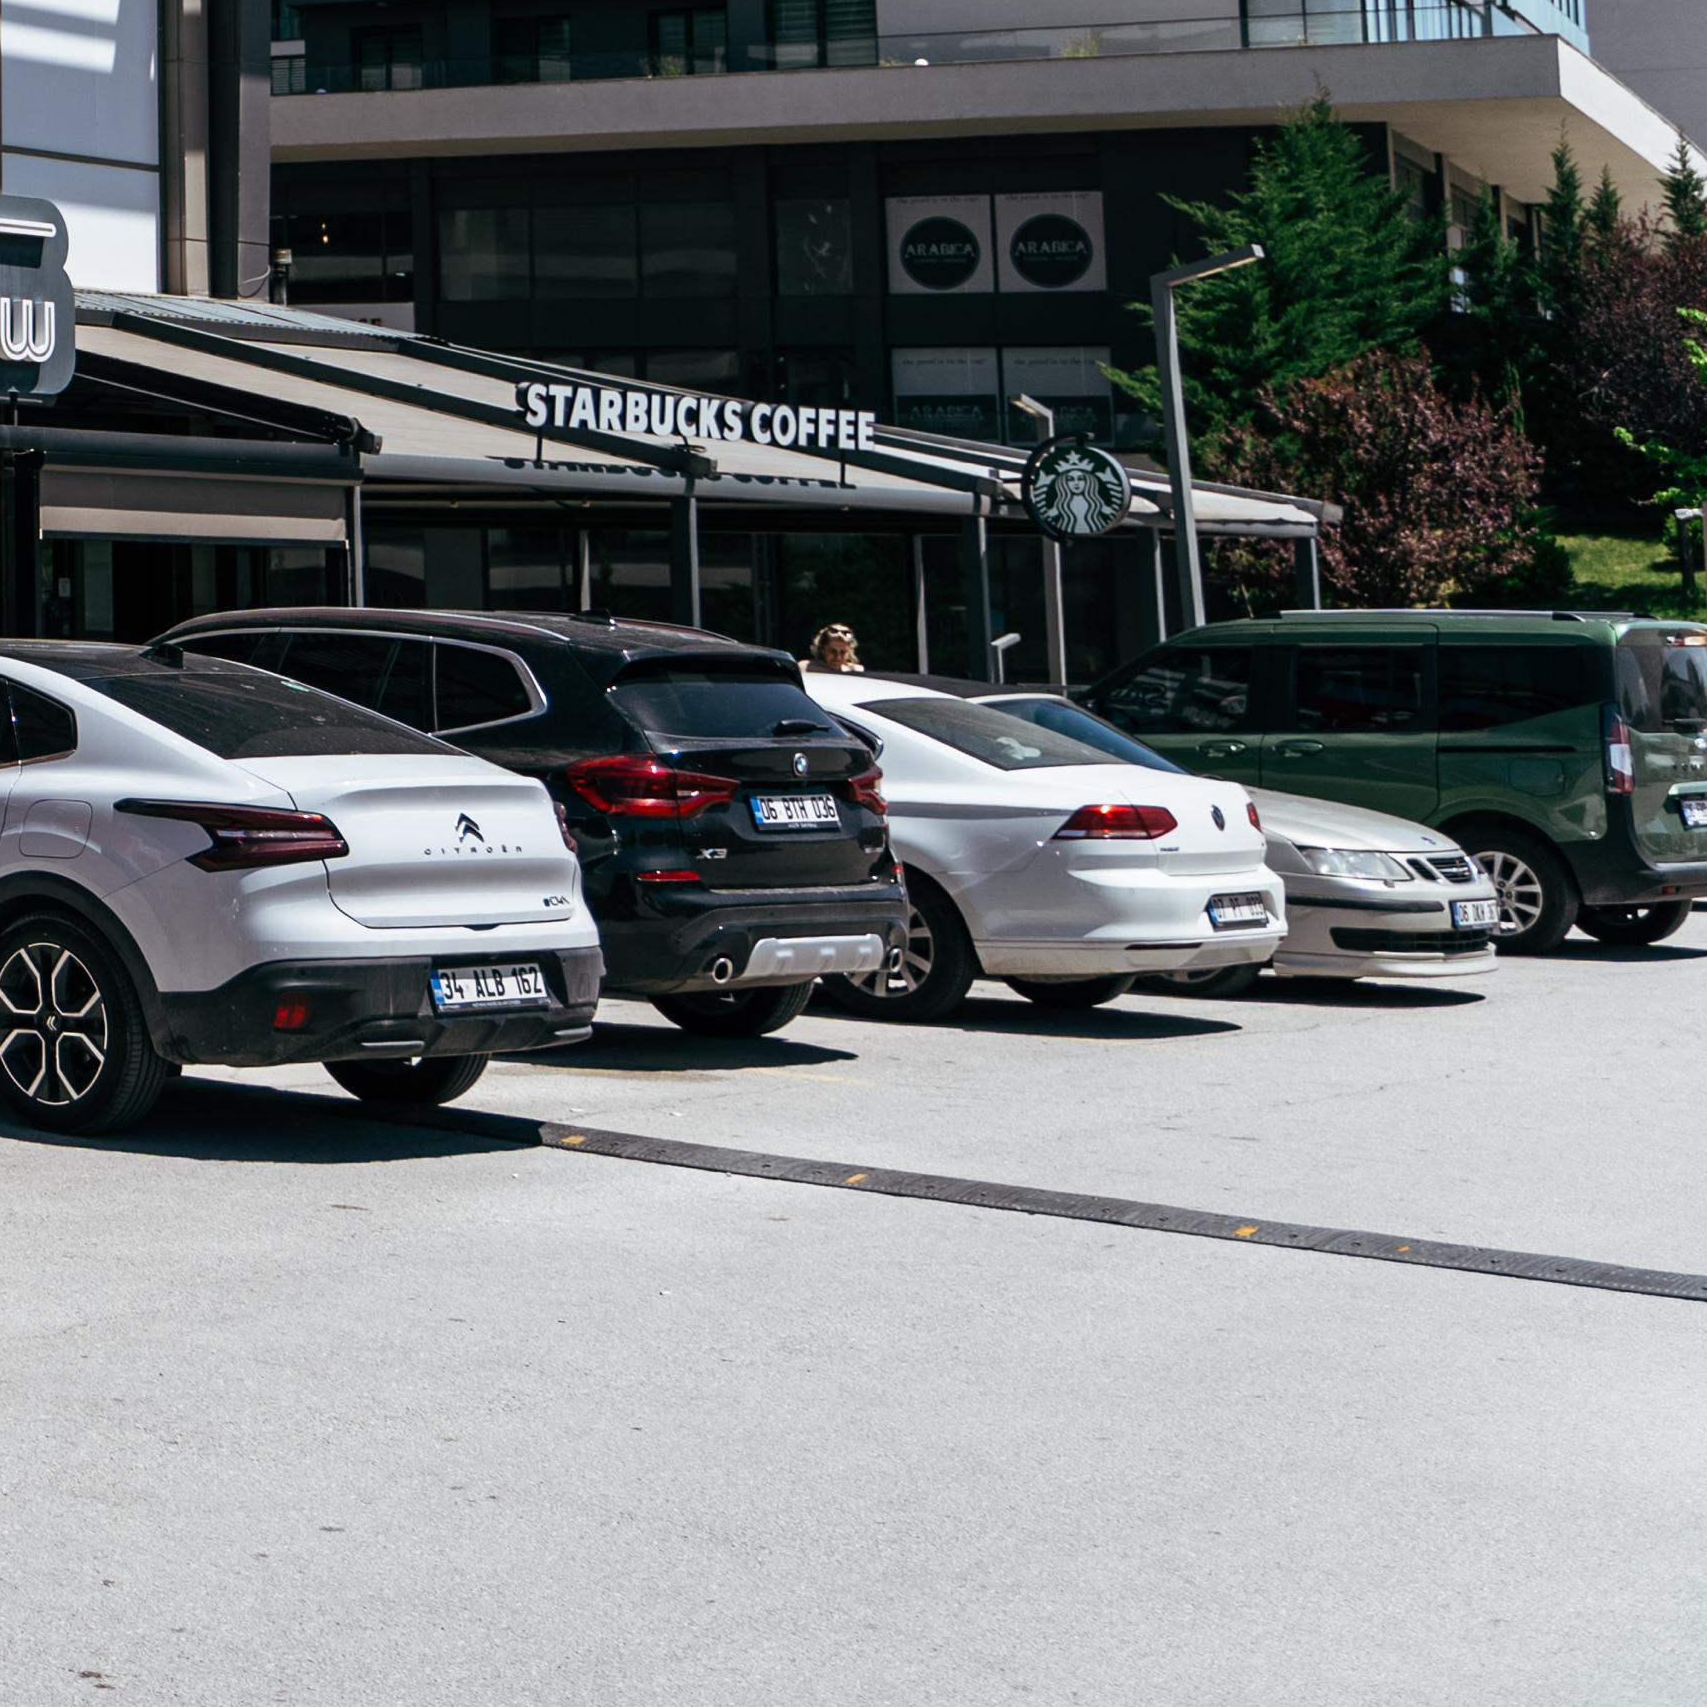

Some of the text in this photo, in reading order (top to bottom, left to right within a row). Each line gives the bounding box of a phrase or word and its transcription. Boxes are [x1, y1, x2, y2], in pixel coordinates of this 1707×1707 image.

[521, 382, 877, 451] STARBUCKS COFFEE
[759, 797, 778, 820] 06
[782, 796, 809, 819] BTH
[696, 847, 728, 860] X3
[440, 966, 543, 1000] 34 ALB 162
